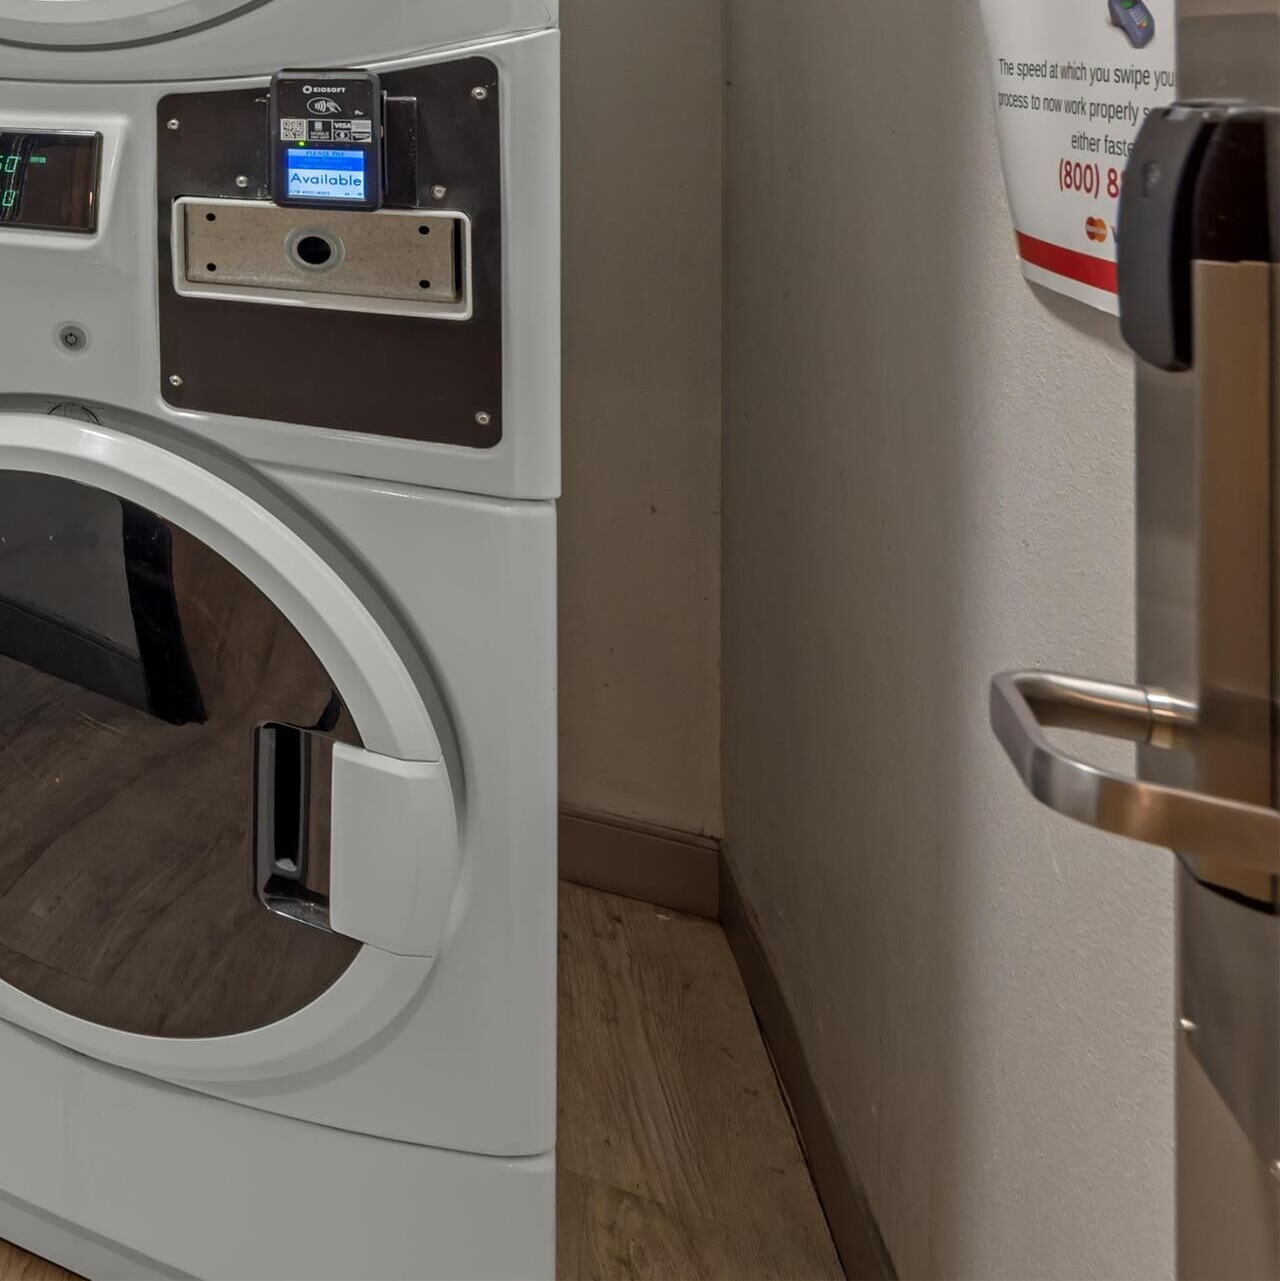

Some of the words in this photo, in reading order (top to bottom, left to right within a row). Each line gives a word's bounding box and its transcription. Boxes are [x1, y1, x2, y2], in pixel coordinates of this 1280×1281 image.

[1071, 131, 1101, 152] either
[290, 173, 362, 186] Available
[1059, 158, 1100, 199] (800)
